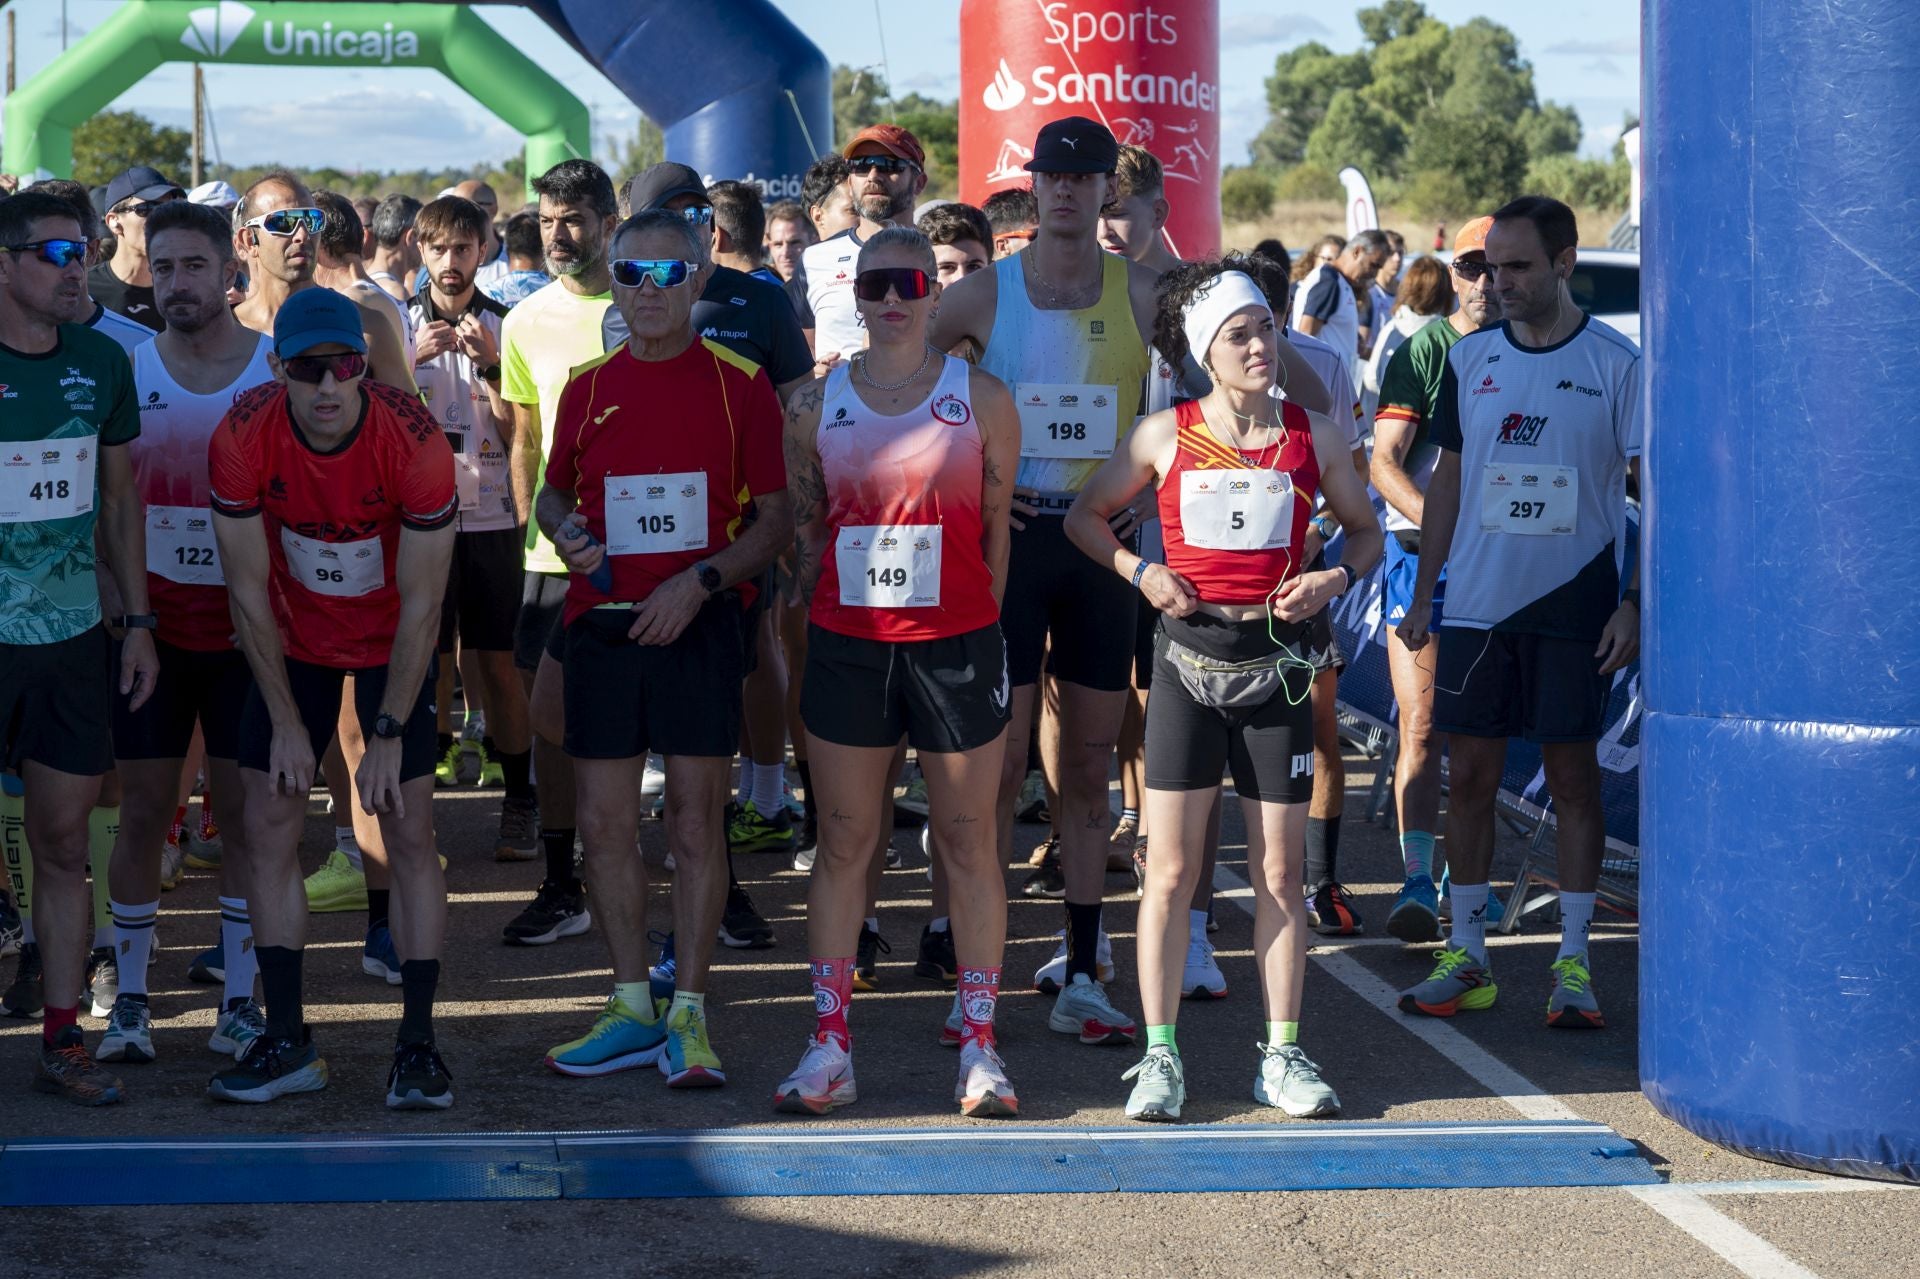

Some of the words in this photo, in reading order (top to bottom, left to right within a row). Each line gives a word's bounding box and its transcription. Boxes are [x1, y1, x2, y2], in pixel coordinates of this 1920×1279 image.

[1044, 2, 1178, 45] Sports
[263, 21, 419, 63] Unicaja
[1032, 65, 1217, 112] Santander
[720, 330, 748, 339] mupol
[1472, 386, 1501, 396] Santander
[1576, 385, 1603, 398] mupol
[825, 420, 855, 431] VIATOR
[1047, 422, 1086, 440] 198
[29, 480, 70, 501] 418
[1509, 501, 1546, 519] 297
[637, 515, 676, 534] 105
[1231, 511, 1245, 530] 5
[174, 546, 215, 566] 122
[315, 568, 344, 583] 96
[866, 567, 907, 587] 149
[1290, 752, 1314, 779] PU
[963, 971, 999, 984] SOLE
